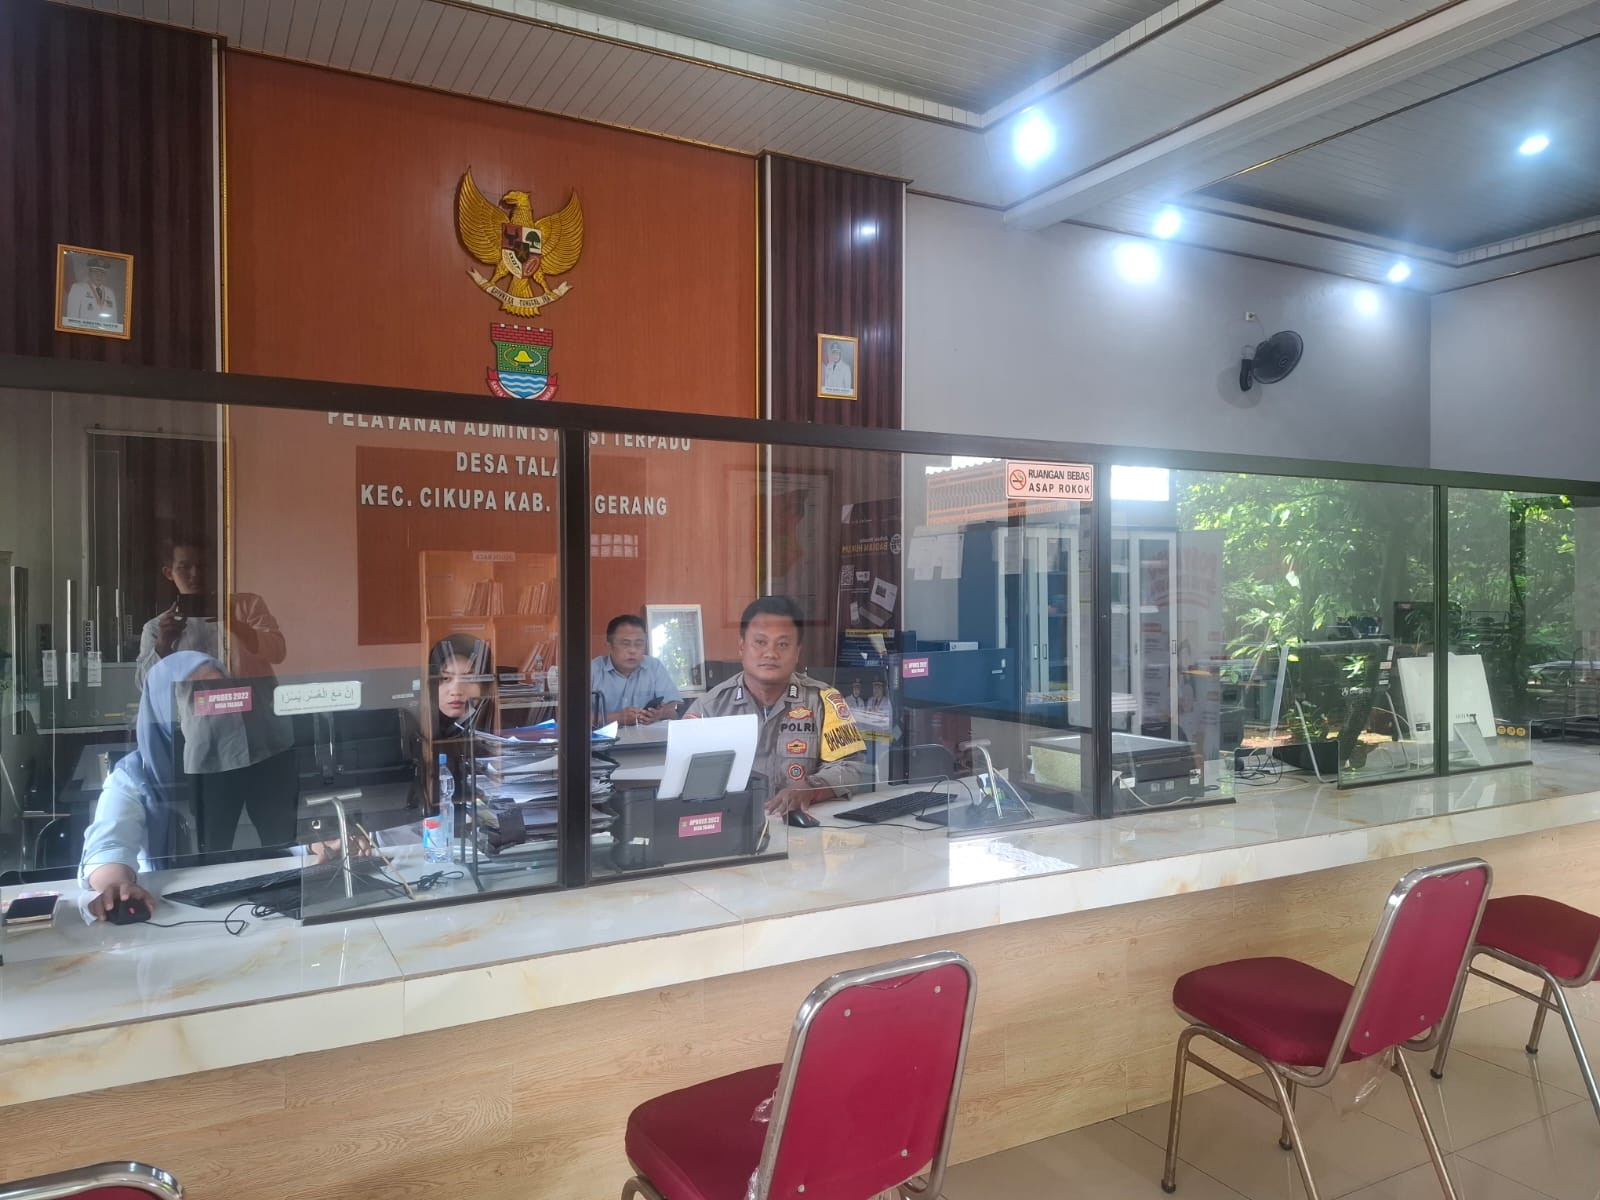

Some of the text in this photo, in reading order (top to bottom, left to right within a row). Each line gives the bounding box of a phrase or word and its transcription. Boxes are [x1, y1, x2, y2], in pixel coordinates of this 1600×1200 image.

[327, 411, 456, 434] PELAYANAN
[615, 433, 691, 451] TERPADU
[456, 451, 509, 474] DESA
[1028, 468, 1090, 481] RUANGAN BEBAS
[1028, 482, 1090, 494] ASAP ROKOK
[360, 484, 412, 507] KEC.
[419, 487, 497, 510] CIKUPA
[504, 490, 551, 512] KAB.
[780, 722, 815, 733] POLRI
